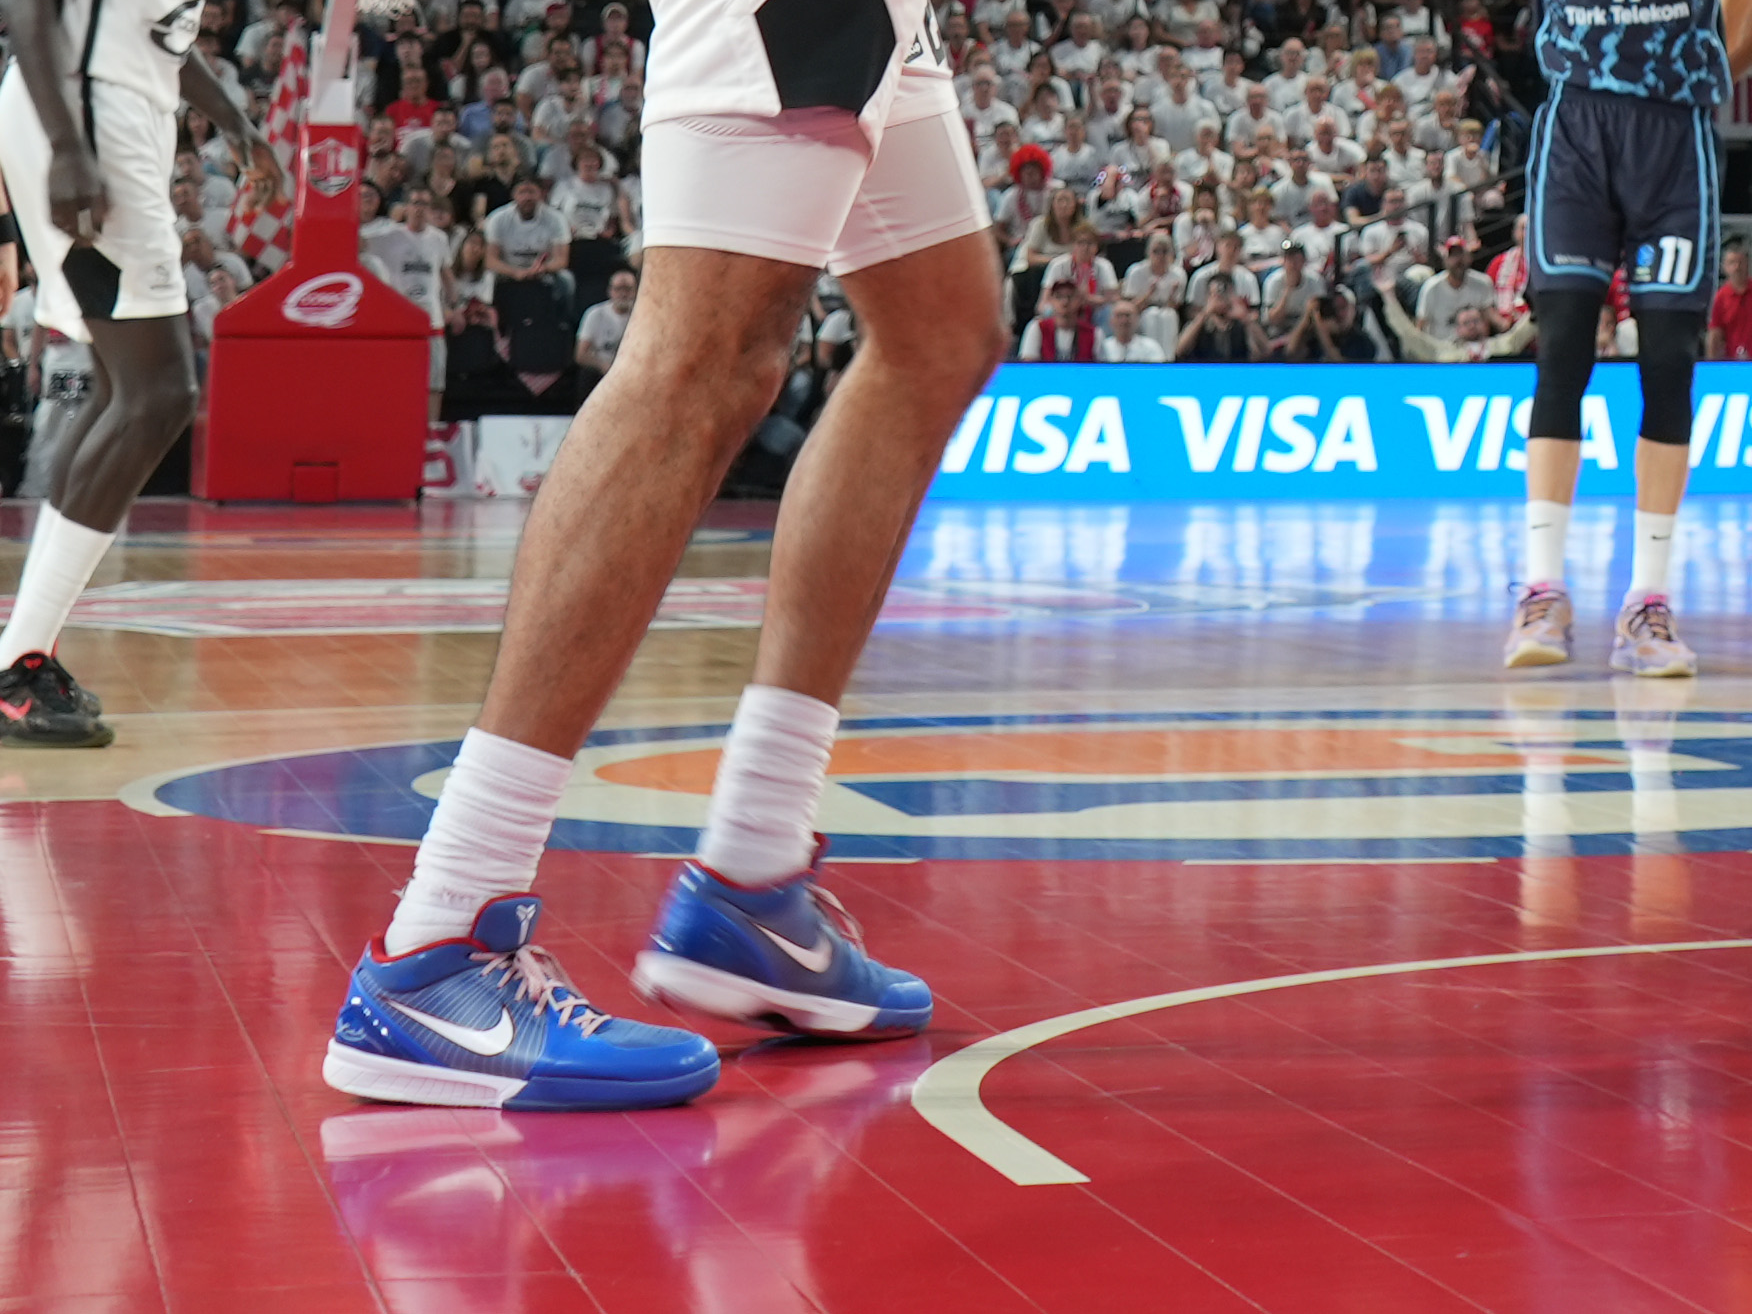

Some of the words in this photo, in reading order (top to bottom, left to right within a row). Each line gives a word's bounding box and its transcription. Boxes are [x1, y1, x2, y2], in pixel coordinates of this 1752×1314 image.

[1608, 0, 1691, 26] Telekom
[1658, 235, 1694, 286] 11
[1155, 396, 1378, 475] VISA
